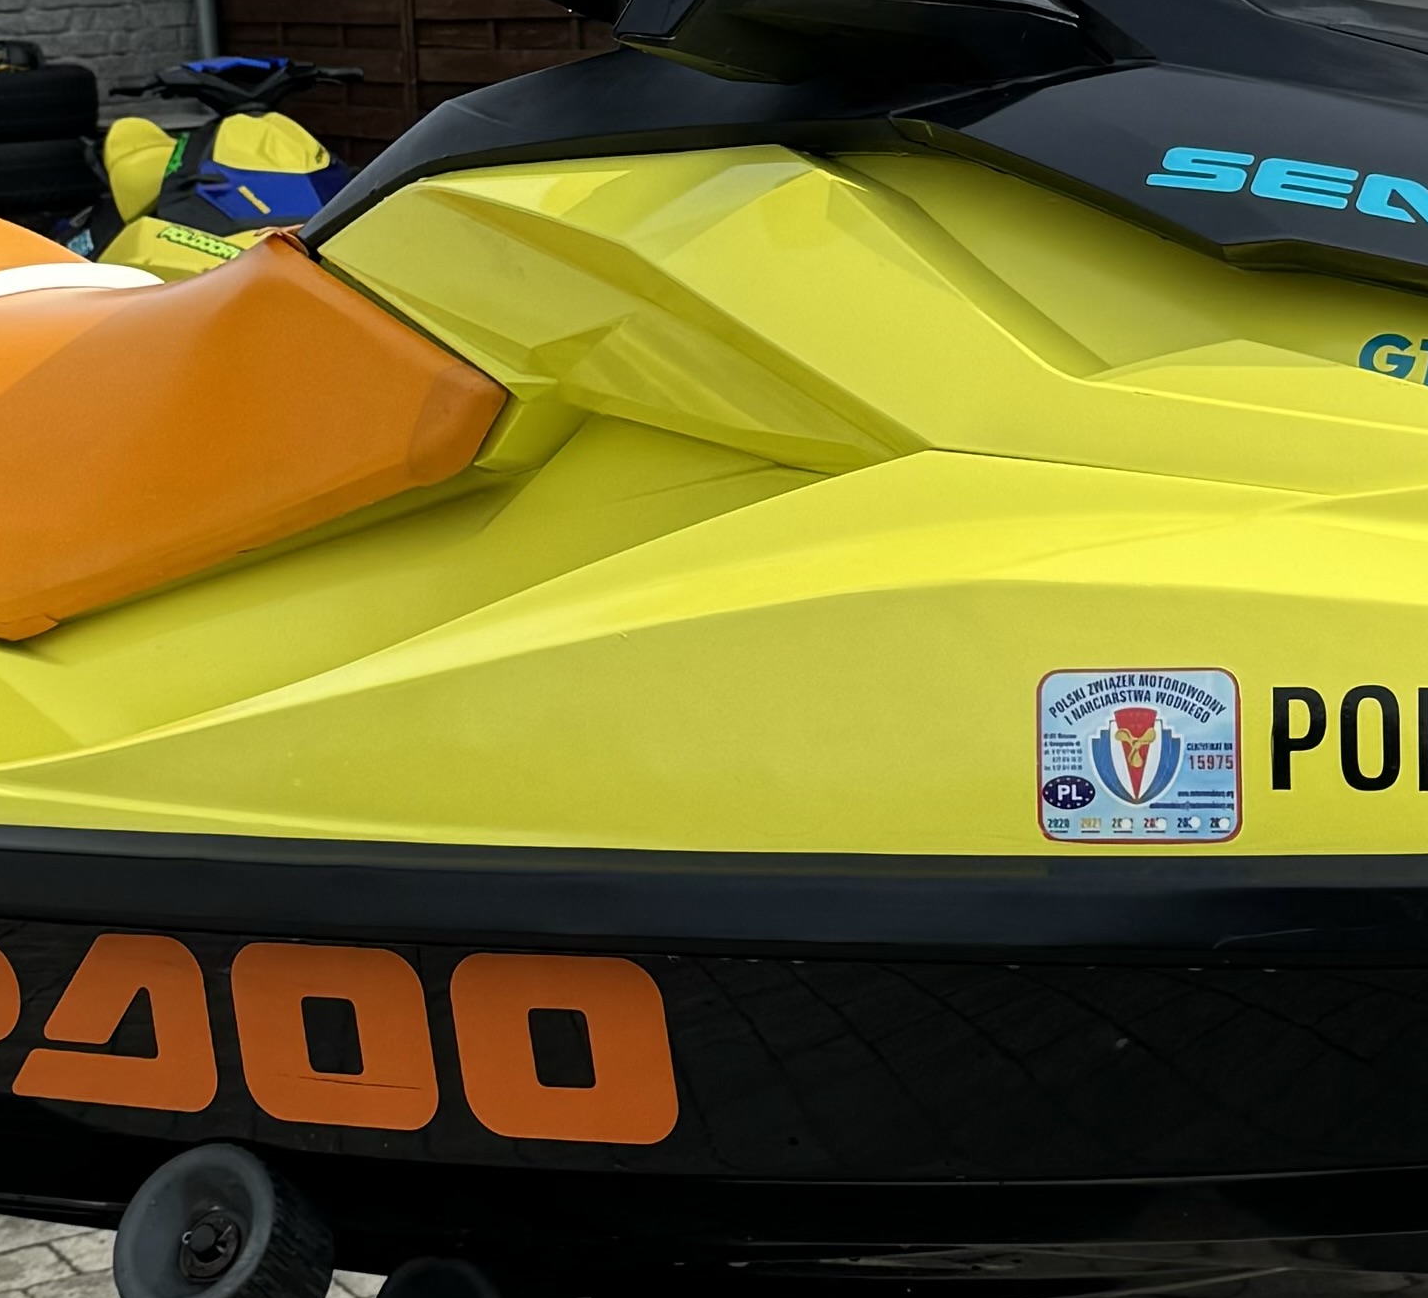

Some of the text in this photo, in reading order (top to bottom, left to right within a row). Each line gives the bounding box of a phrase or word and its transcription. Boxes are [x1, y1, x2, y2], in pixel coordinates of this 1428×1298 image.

[1048, 687, 1086, 718] POLSKI
[1138, 673, 1227, 716] MOTOROWODNY
[1071, 689, 1151, 721] NARCIARSTWA
[1155, 690, 1211, 724] WODNEGO
[1189, 754, 1234, 770] 15975
[1057, 784, 1083, 801] PL
